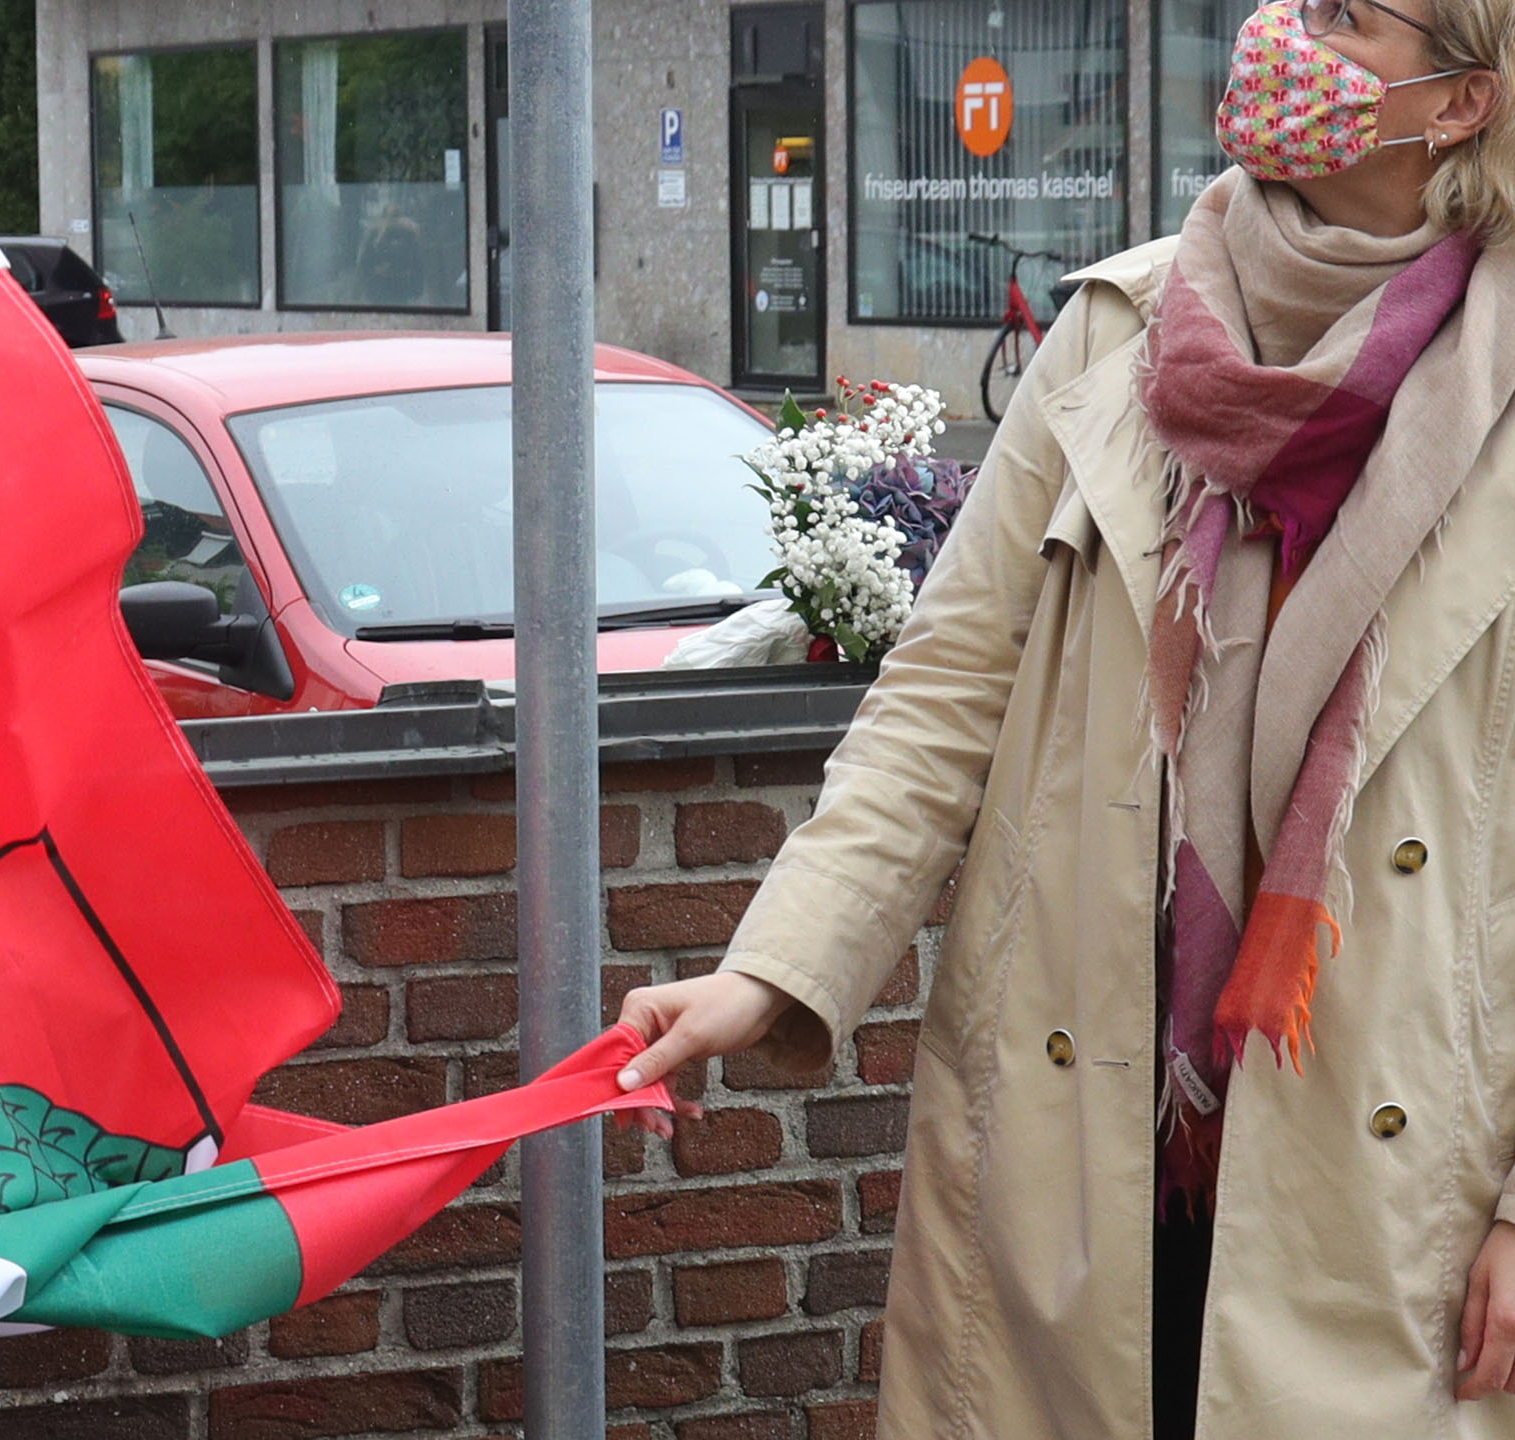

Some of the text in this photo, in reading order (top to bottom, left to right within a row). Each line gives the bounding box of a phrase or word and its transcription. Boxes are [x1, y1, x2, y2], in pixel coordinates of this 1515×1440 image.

[963, 82, 1005, 132] FT
[863, 169, 1113, 201] friseurteam thomas kaschel
